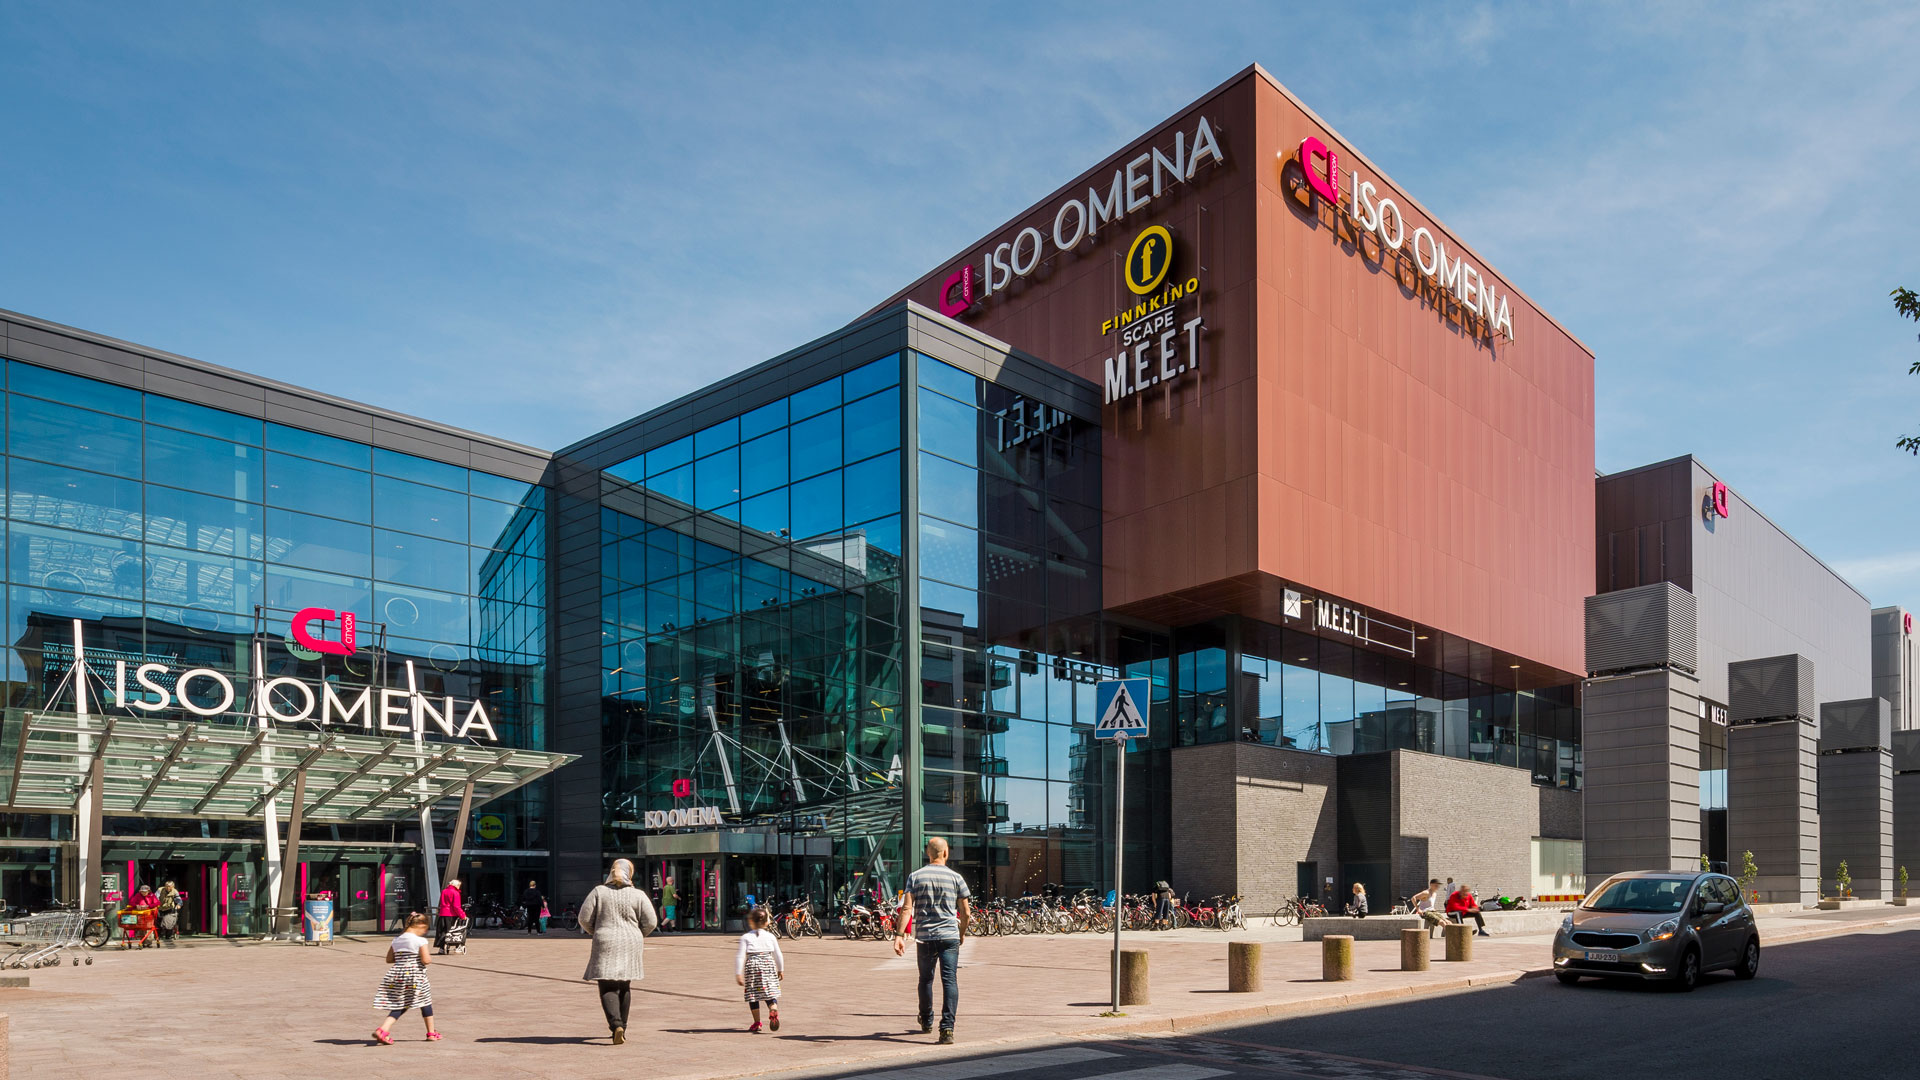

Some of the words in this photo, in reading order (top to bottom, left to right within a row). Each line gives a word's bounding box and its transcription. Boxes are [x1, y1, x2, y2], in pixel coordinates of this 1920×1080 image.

[984, 227, 1043, 296] ISO
[1053, 115, 1224, 250] OMENA
[1350, 170, 1404, 250] ISO
[1411, 227, 1514, 341] OMENA
[1102, 277, 1199, 336] FINNKINO
[1123, 310, 1175, 347] SCAPE
[1104, 316, 1202, 405] M.E.E.T
[345, 614, 353, 644] CITYCON
[1318, 598, 1361, 638] M.E.E.T
[116, 660, 235, 716] ISO
[262, 677, 498, 741] OMENA
[644, 809, 668, 830] ISO
[668, 805, 724, 828] OMENA
